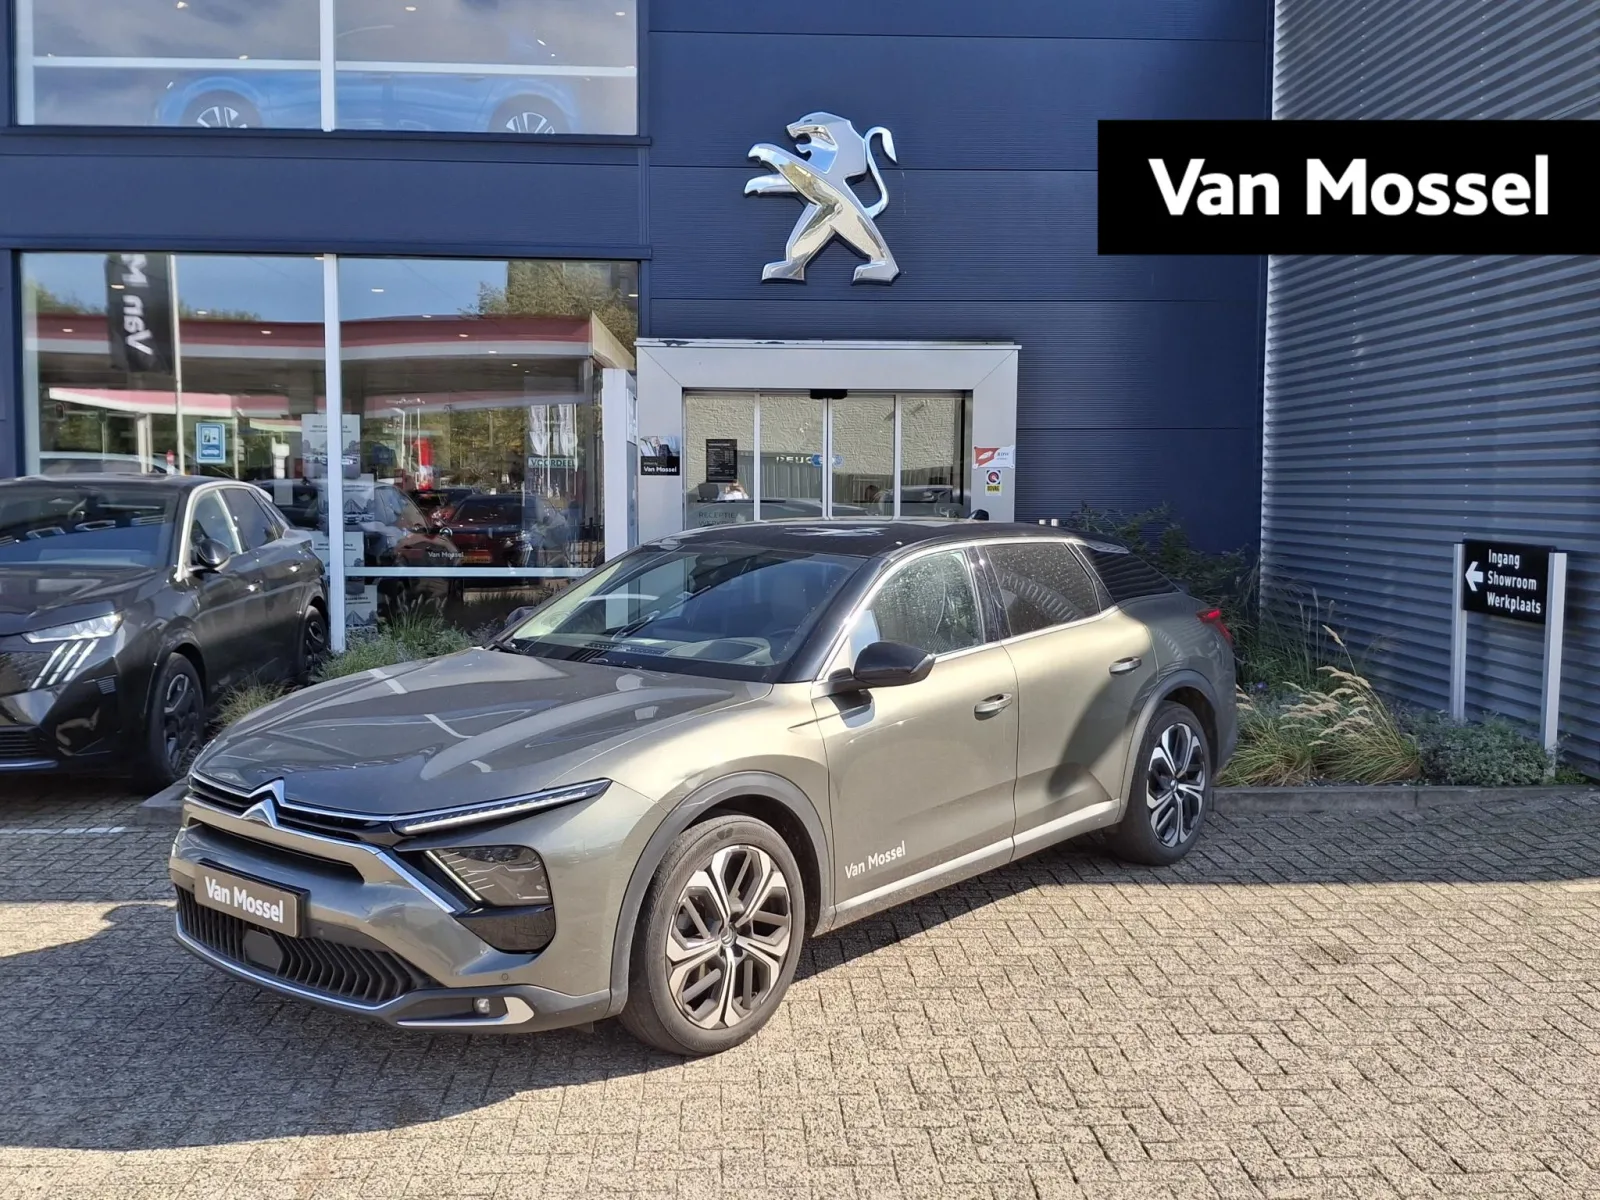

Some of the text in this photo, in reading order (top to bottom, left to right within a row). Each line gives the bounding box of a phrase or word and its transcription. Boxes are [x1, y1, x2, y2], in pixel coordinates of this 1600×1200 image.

[441, 551, 465, 559] Mossel
[1488, 549, 1520, 569] Ingang
[1487, 570, 1537, 591] Showroom
[1486, 591, 1541, 614] Werkplaats
[844, 840, 906, 879] Van Mossel
[204, 876, 284, 923] Van Mossel
